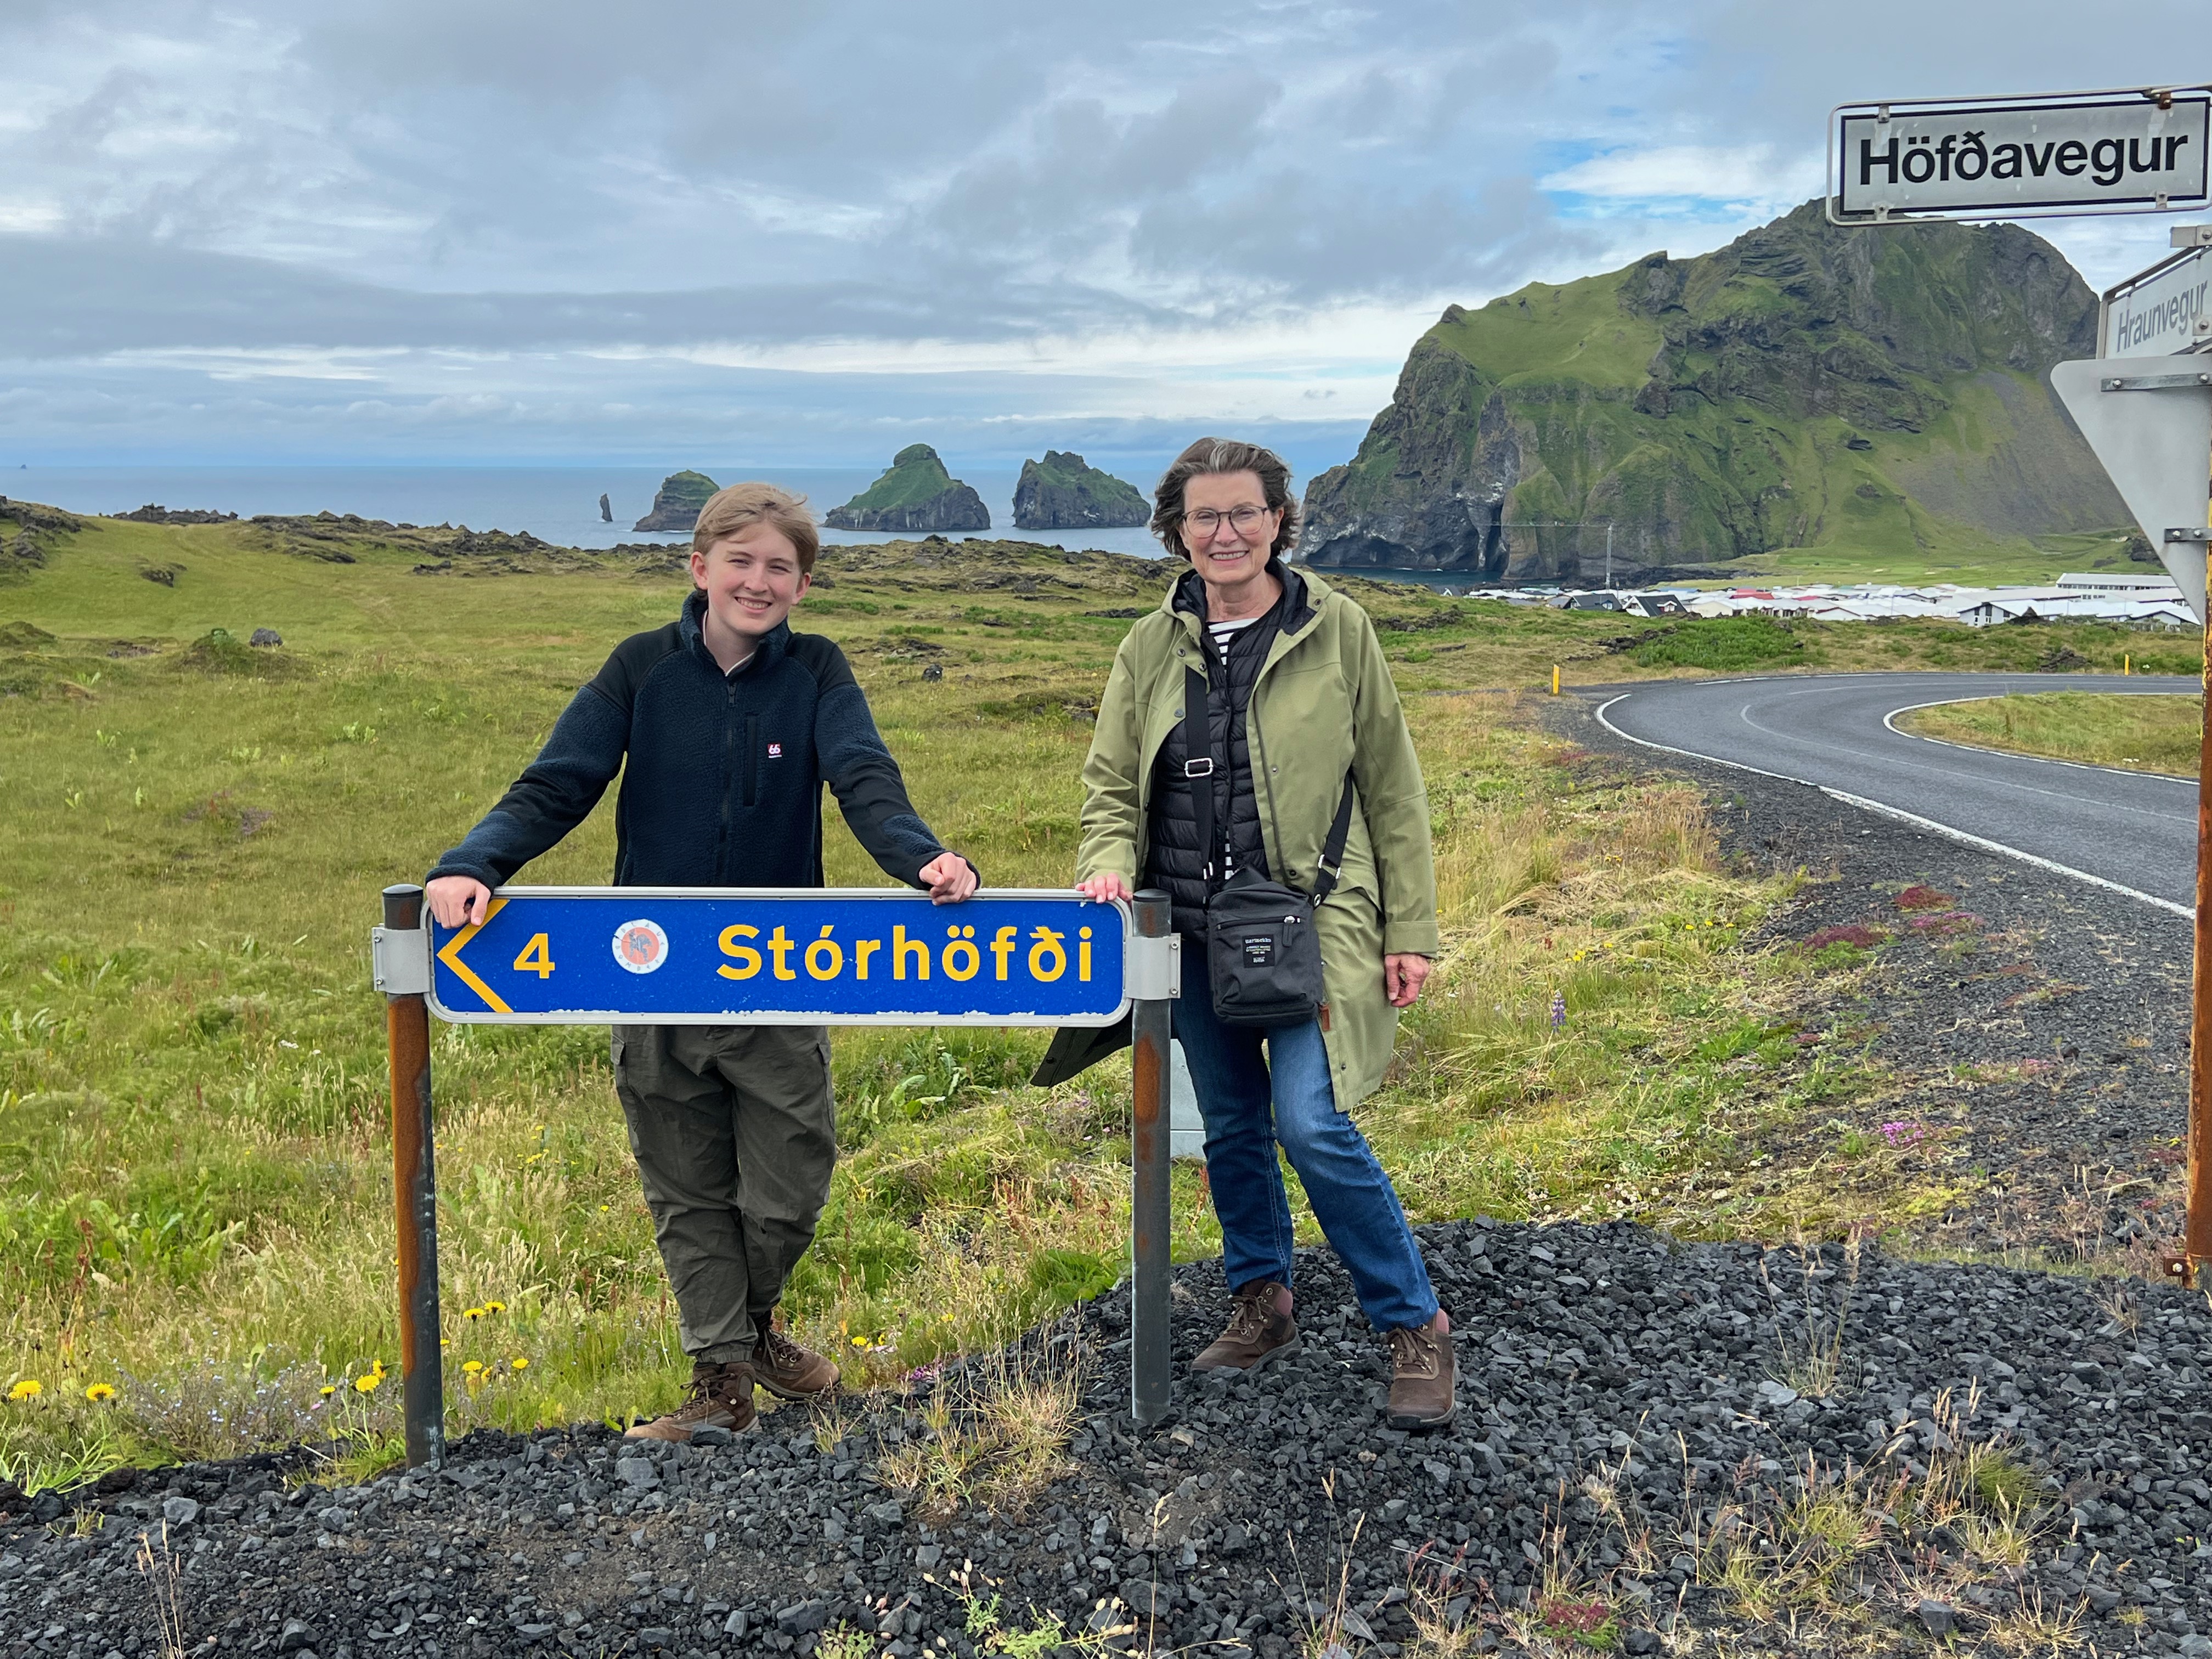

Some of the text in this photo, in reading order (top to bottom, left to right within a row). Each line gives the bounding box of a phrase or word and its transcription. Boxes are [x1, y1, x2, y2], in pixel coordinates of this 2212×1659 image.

[1860, 131, 2188, 186] Höfðavegur
[2117, 280, 2208, 353] Hraunvegur
[514, 924, 1092, 981] 4 Stórhöfði
